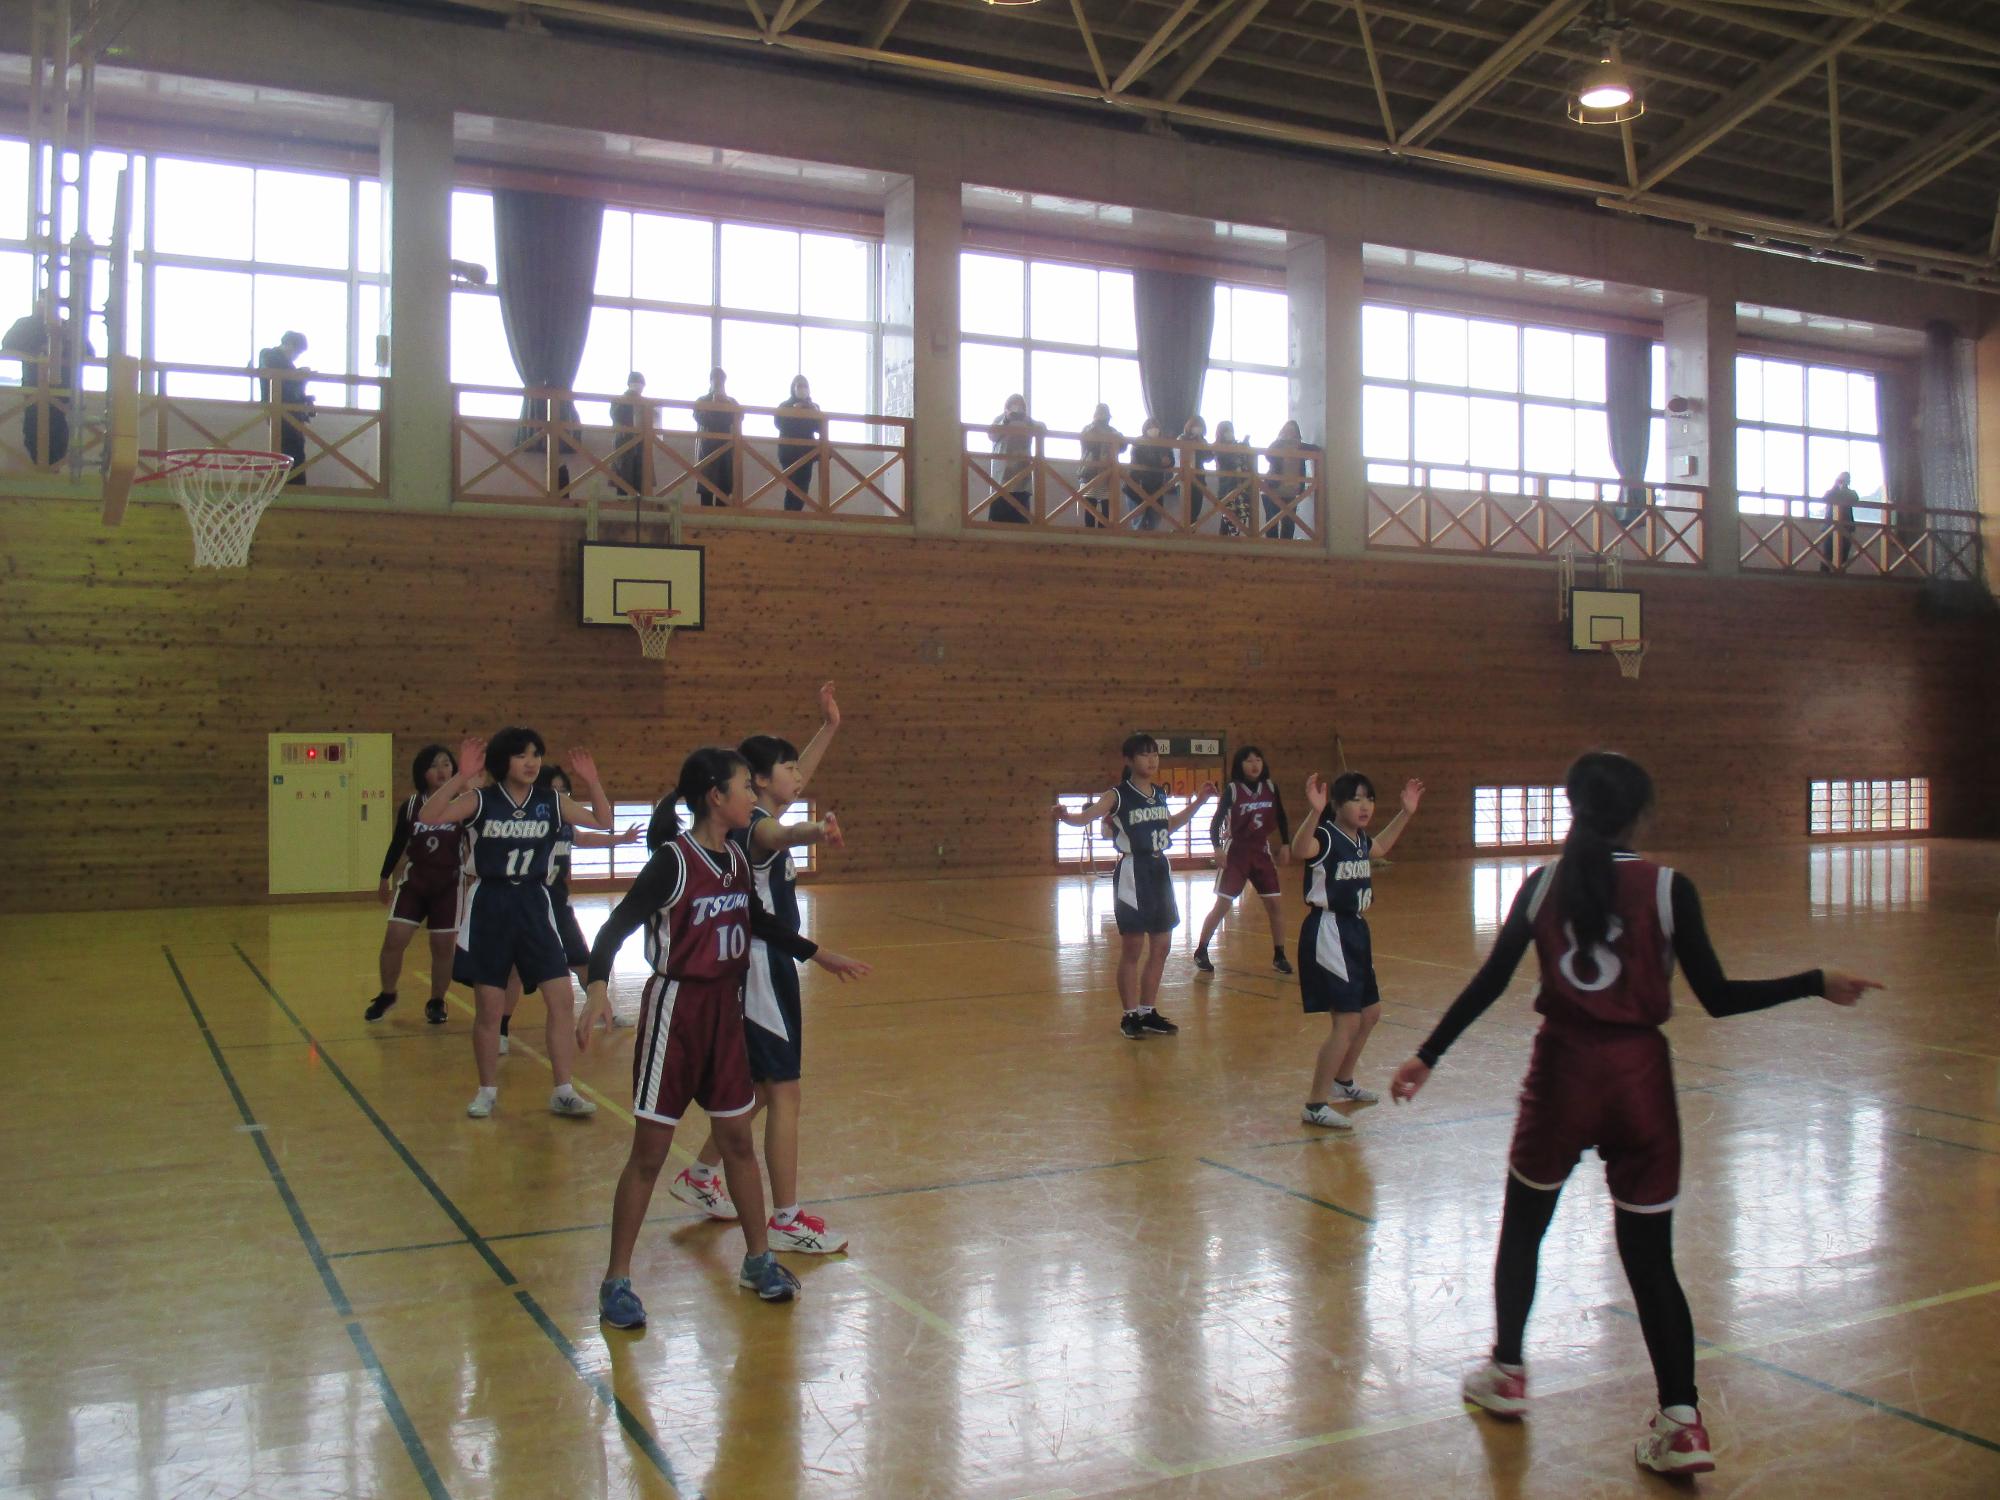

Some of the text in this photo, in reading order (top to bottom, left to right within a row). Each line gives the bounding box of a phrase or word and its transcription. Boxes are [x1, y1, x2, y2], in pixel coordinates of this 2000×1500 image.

[482, 819, 550, 838] ISOSHO
[426, 836, 440, 853] 9
[506, 848, 535, 876] 11
[716, 923, 745, 961] 10
